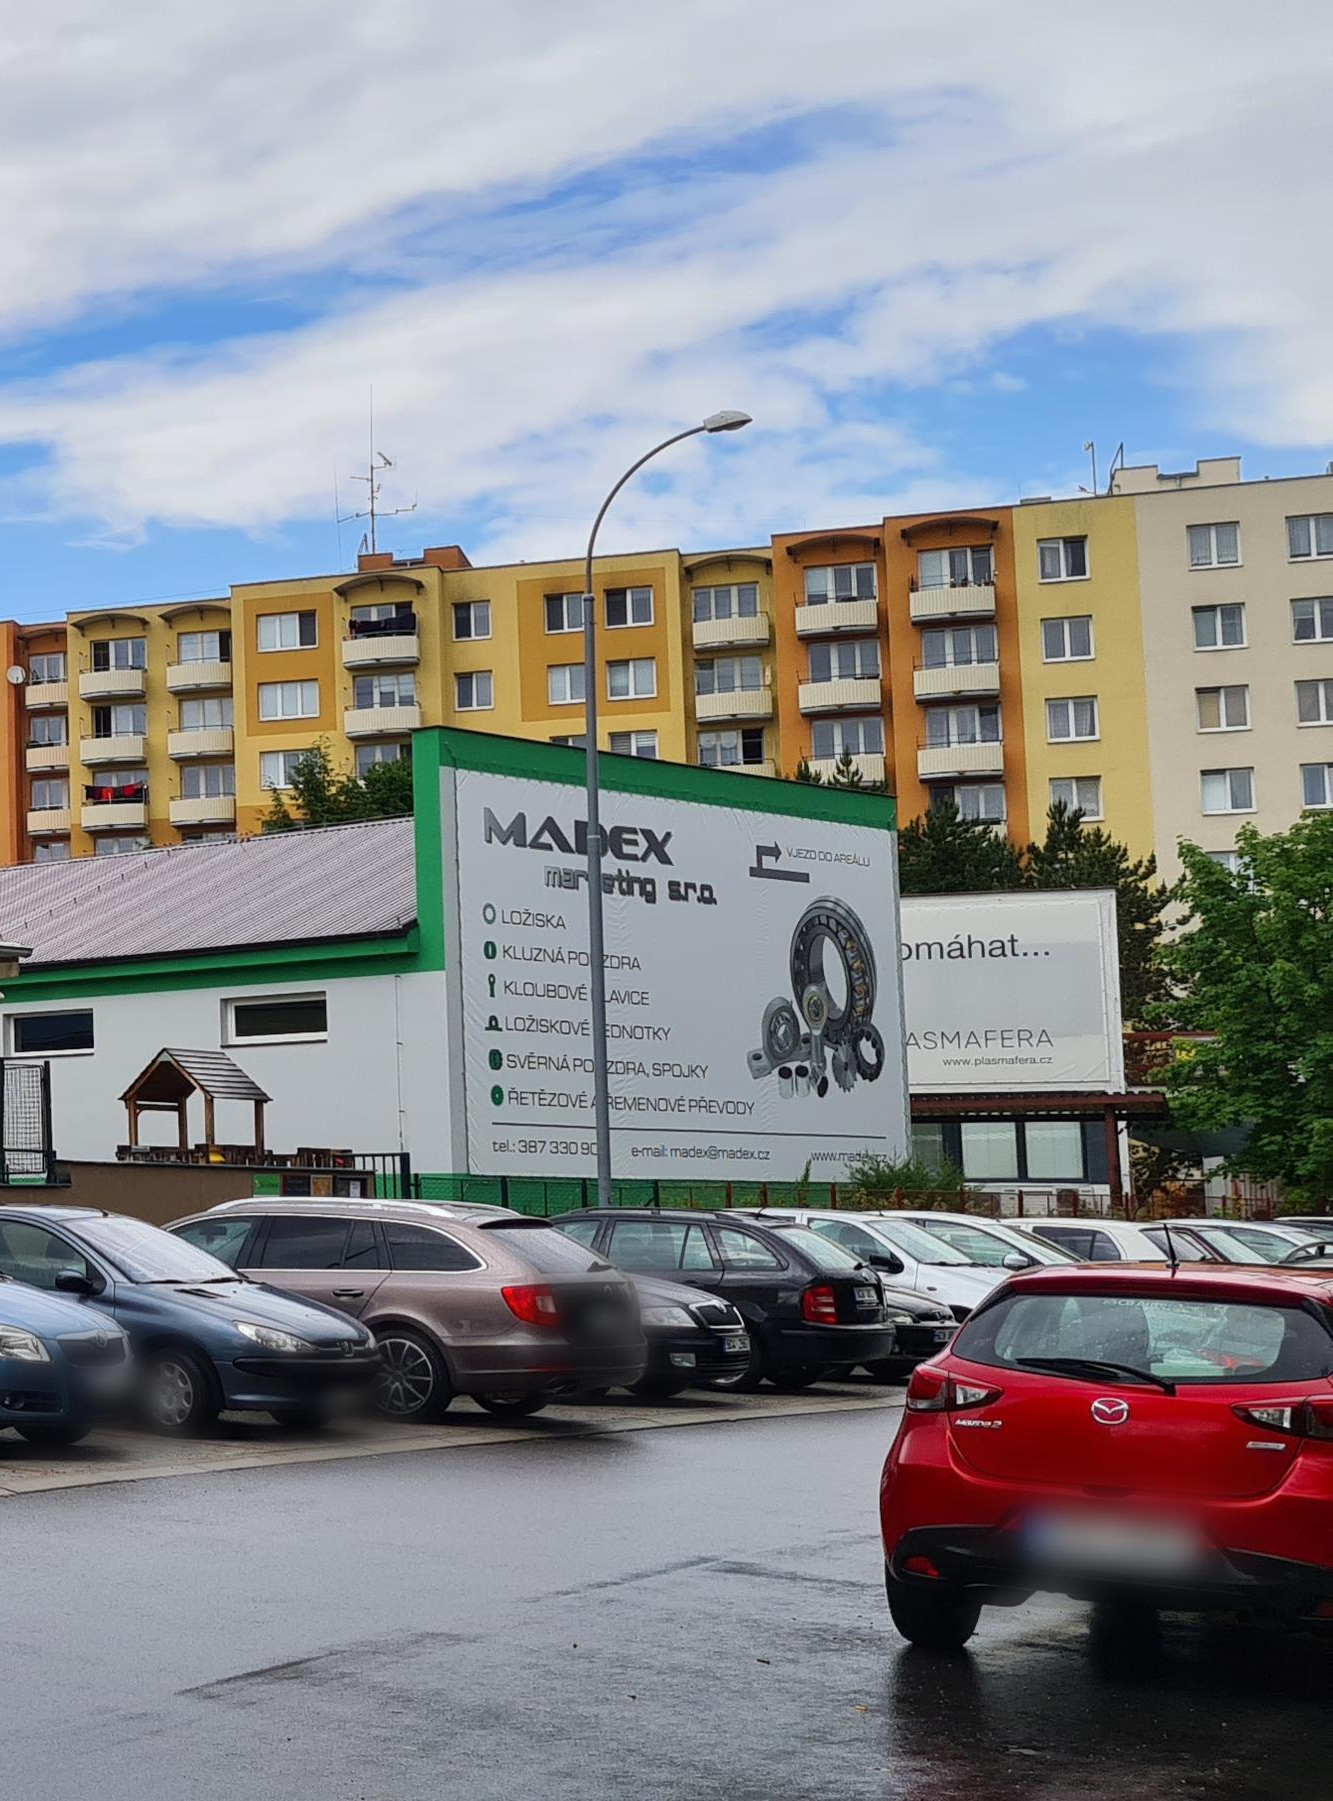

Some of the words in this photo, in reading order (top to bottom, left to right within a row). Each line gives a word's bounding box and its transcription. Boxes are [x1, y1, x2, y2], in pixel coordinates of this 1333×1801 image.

[483, 806, 674, 866] MADEX
[786, 847, 817, 860] VJEZD
[818, 850, 833, 862] DO
[834, 852, 871, 867] AREÁLU
[544, 865, 657, 904] mareting
[668, 880, 718, 906] s.r.o.
[501, 908, 567, 930] LOŽISKA
[502, 944, 566, 964] KLUZNÁ
[567, 951, 642, 971] POZDRA
[901, 933, 1050, 961] omáhat...
[503, 980, 588, 1001] KLOUBOVÉ
[505, 1015, 591, 1037] LOŽISKOVÉ
[604, 1023, 671, 1041] EDNOTKY
[906, 1028, 1054, 1050] ASMAFERA
[506, 1052, 571, 1072] SVĚRNÁ
[572, 1057, 650, 1078] POZDRA,
[652, 1062, 709, 1079] SPOJKY
[942, 1055, 1053, 1067] www.plasmafera.cz
[508, 1087, 588, 1109] ŘETĚZOVÉ
[688, 1096, 755, 1115] PŘEVODY
[492, 1140, 516, 1153] tel.:
[518, 1140, 546, 1154] 387
[549, 1141, 578, 1155] 330
[580, 1142, 598, 1156] 90
[631, 1145, 668, 1158] e-mail:
[670, 1146, 770, 1161] madex@madex.cz
